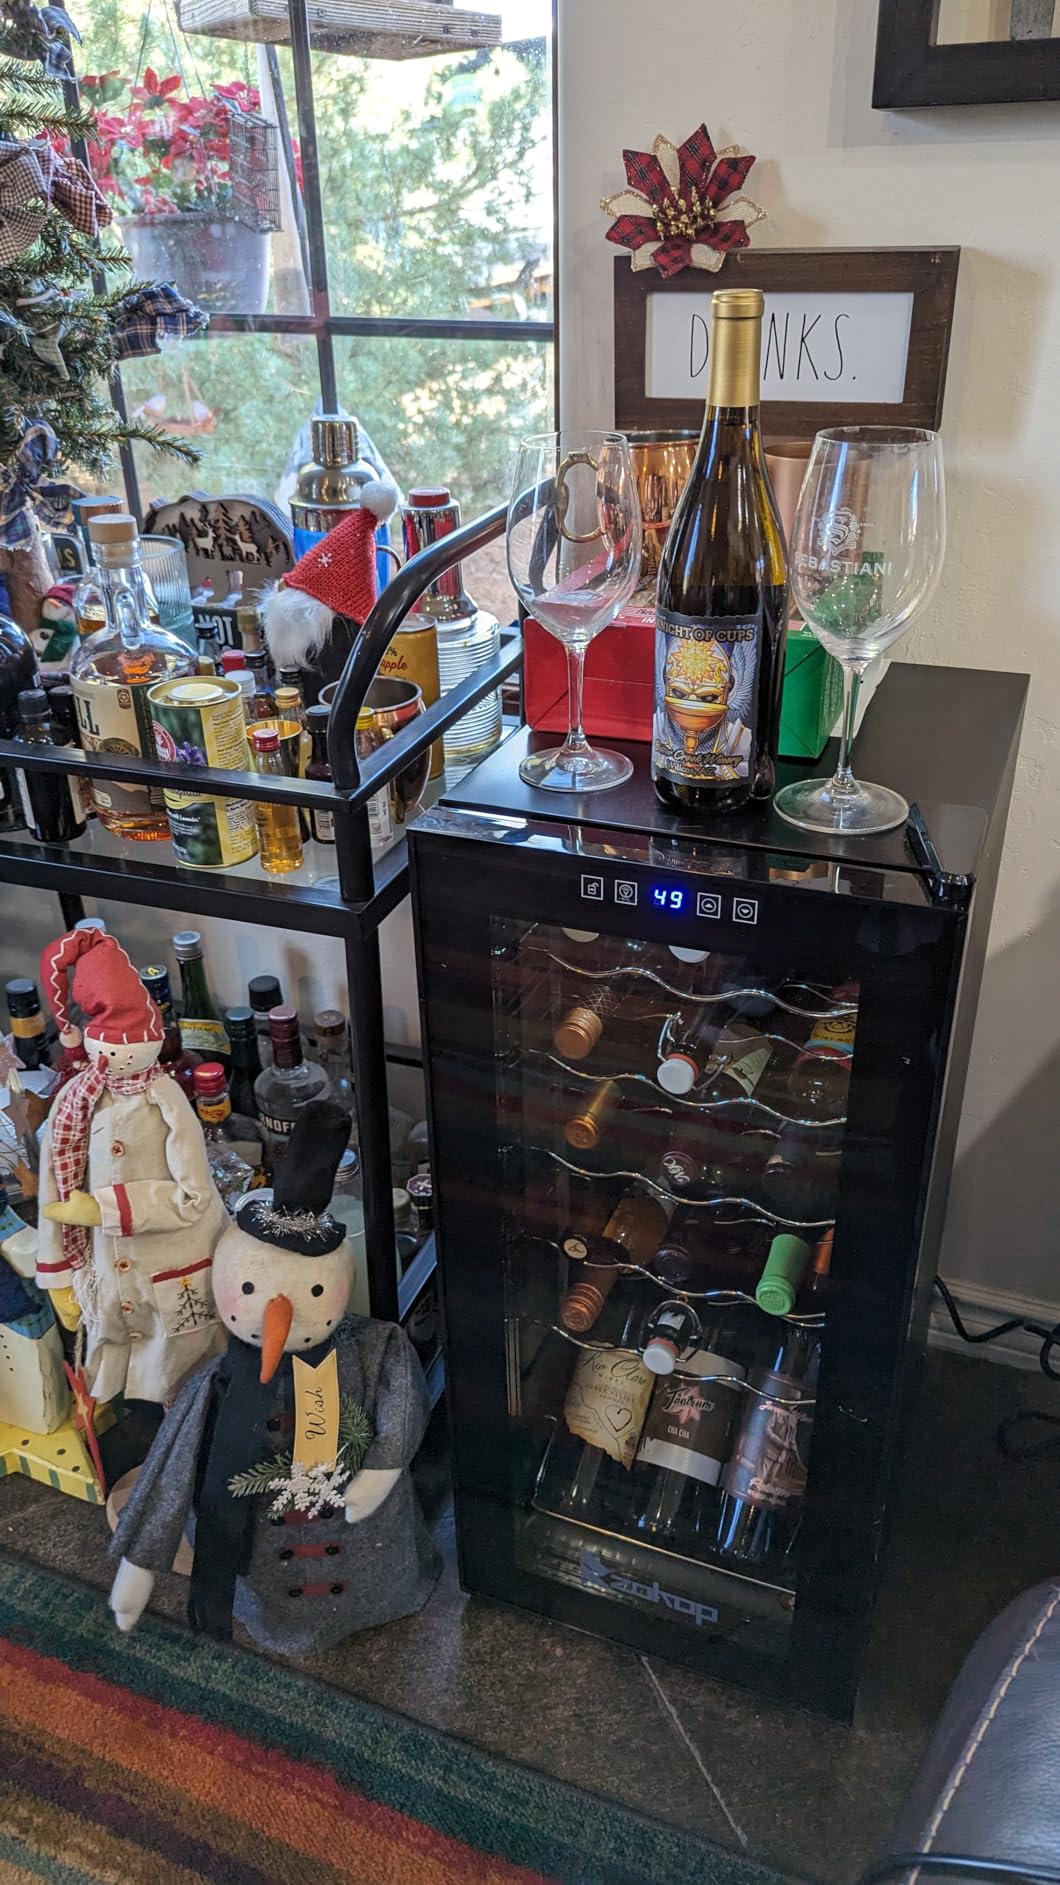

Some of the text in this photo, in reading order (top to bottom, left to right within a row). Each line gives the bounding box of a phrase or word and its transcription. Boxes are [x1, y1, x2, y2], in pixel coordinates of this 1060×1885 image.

[690, 312, 857, 381] DNKS.
[794, 551, 893, 576] SEBASTIANI
[693, 629, 714, 641] OF
[716, 629, 755, 642] CUPS
[654, 889, 684, 909] 49
[583, 1351, 648, 1386] Rio Claro
[663, 1386, 713, 1413] Tantrum
[304, 1386, 327, 1441] Wish
[667, 1425, 678, 1437] CHA
